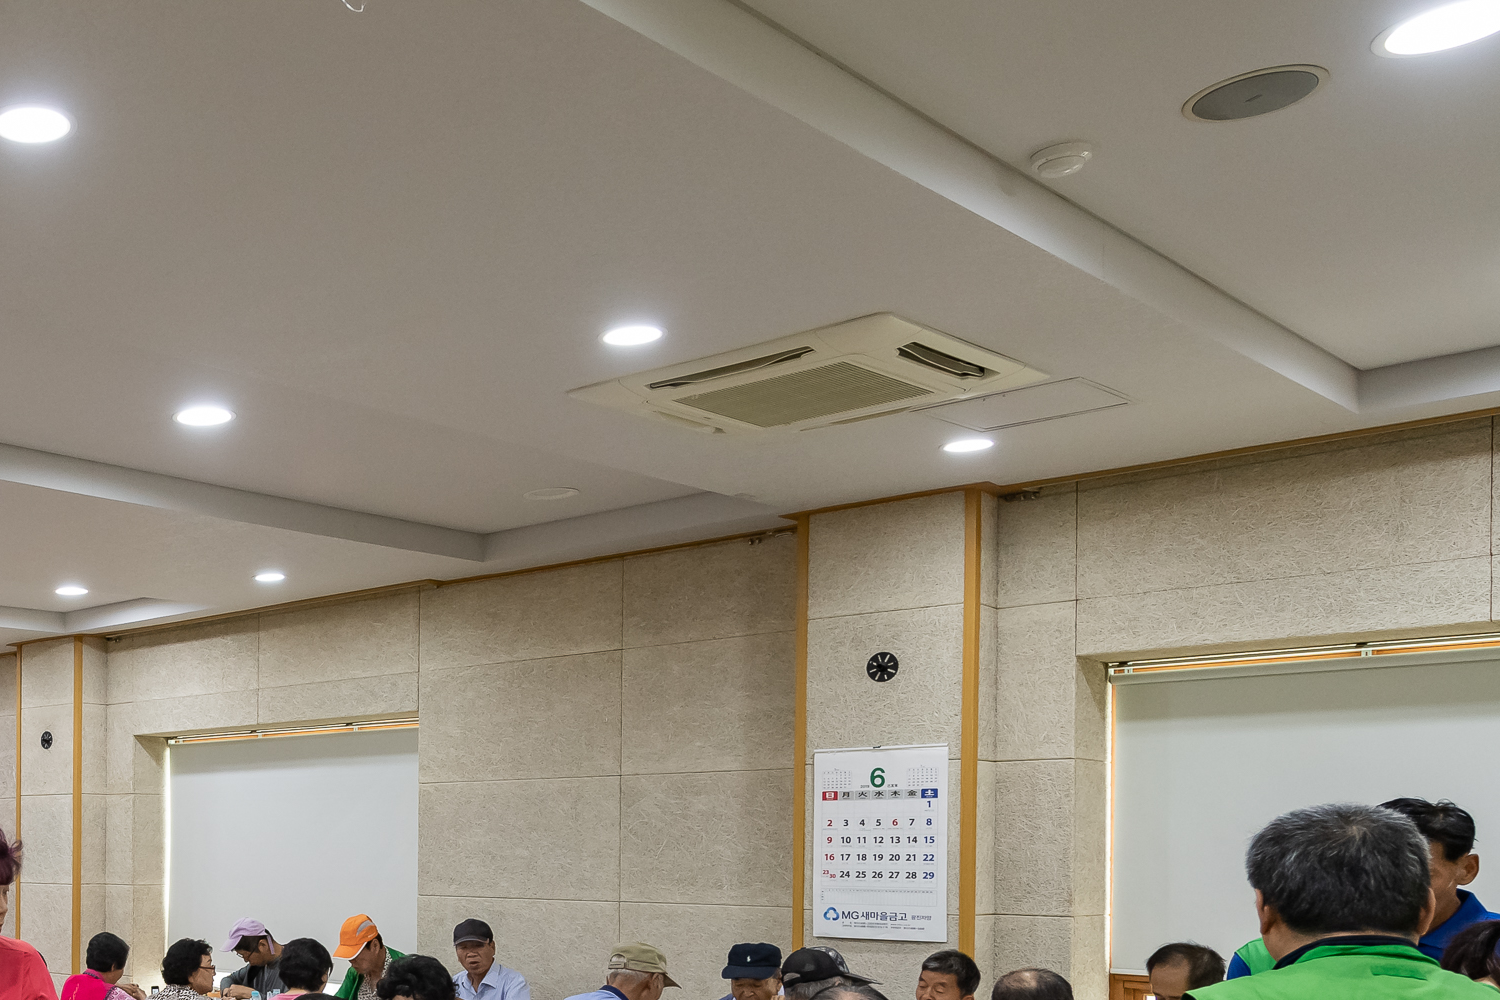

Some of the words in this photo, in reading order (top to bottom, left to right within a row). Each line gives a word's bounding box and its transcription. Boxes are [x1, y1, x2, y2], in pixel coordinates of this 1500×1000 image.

[870, 767, 886, 788] 6
[907, 789, 917, 797] 金
[927, 800, 932, 808] 1
[827, 819, 833, 827] 2
[843, 819, 849, 827] 3
[859, 819, 866, 827] 4
[875, 819, 882, 827] 5
[892, 818, 899, 827] 6
[909, 818, 915, 826] 7
[926, 818, 933, 826] 8
[827, 836, 833, 844] 9
[840, 836, 851, 844] 10
[856, 836, 867, 844] 11
[873, 836, 884, 844] 12
[889, 836, 901, 844] 13
[906, 836, 918, 844] 14
[923, 835, 935, 844] 15
[824, 853, 835, 861] 16
[840, 853, 851, 861] 17
[856, 853, 867, 861] 18
[872, 853, 884, 862] 19
[888, 853, 901, 862] 20
[905, 853, 917, 862] 21
[922, 853, 935, 862] 22
[839, 870, 851, 878] 24
[855, 870, 867, 879] 25
[871, 870, 884, 879] 26
[888, 870, 900, 879] 27
[905, 871, 917, 879] 28
[922, 871, 935, 880] 29
